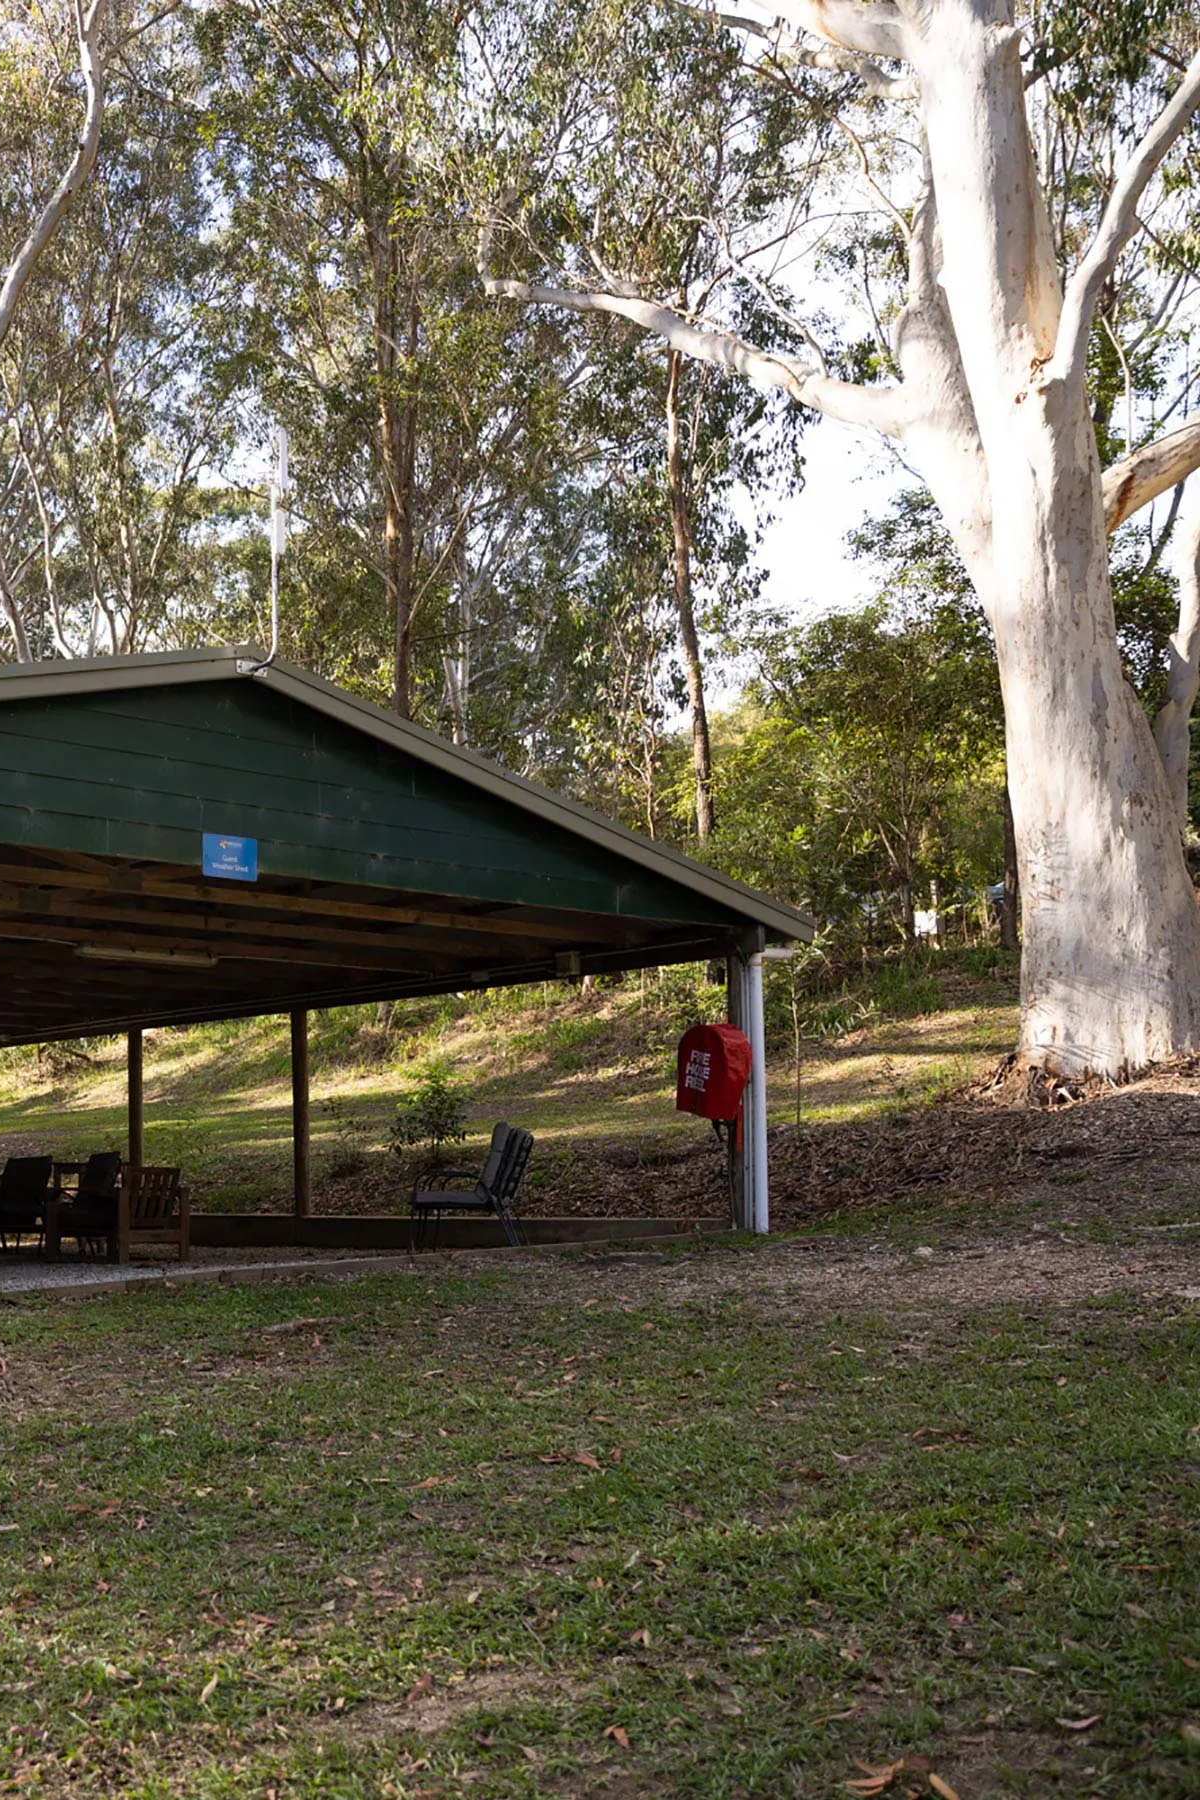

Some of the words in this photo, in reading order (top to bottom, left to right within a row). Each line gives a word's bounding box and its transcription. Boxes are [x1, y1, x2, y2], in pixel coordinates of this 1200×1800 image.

[690, 1050, 711, 1066] FIRE
[685, 1062, 711, 1080] HOSE
[685, 1075, 706, 1092] REEL
